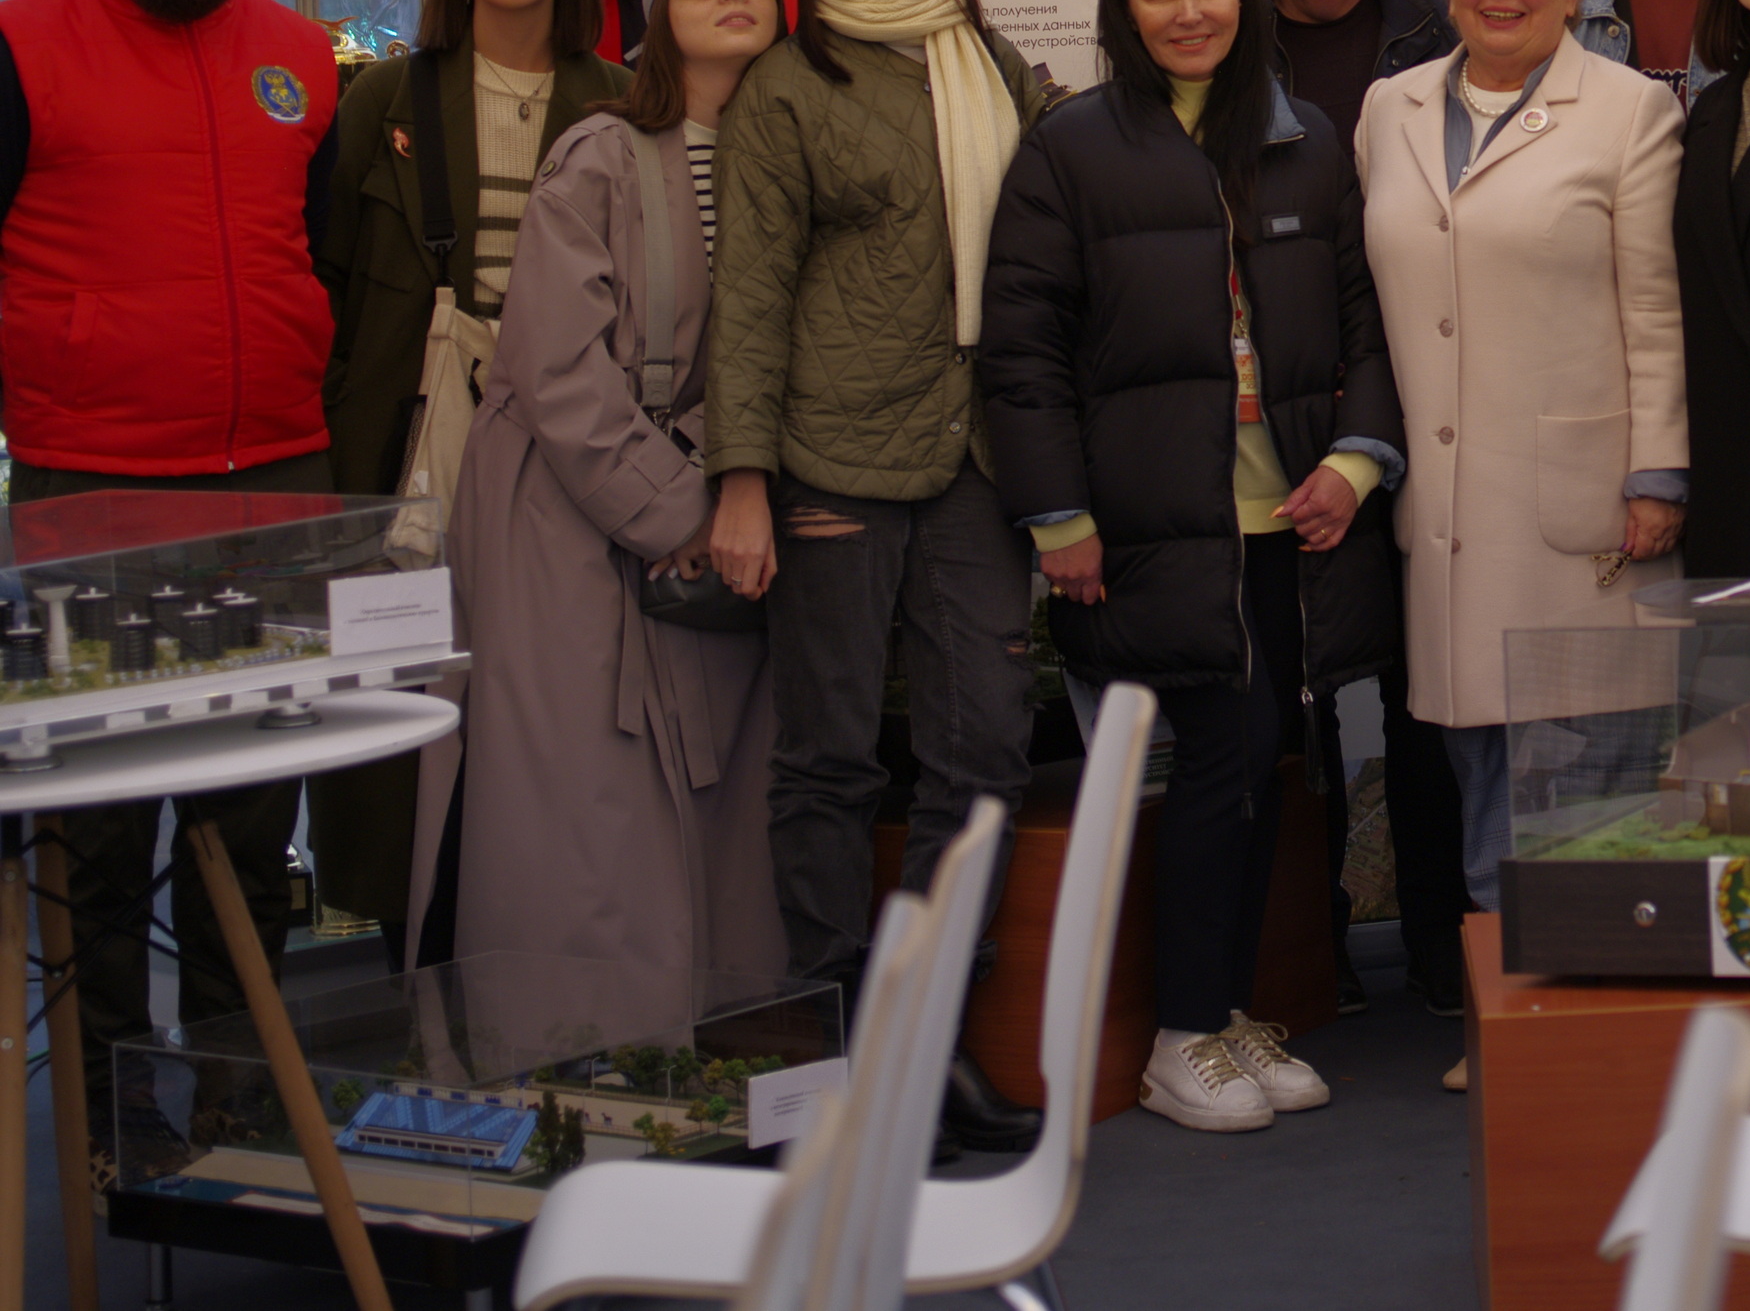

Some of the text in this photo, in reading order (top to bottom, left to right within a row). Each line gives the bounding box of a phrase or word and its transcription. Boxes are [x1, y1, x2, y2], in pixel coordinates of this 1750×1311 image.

[992, 5, 1058, 18] получения
[998, 20, 1091, 33] енных данных
[1011, 34, 1097, 50] леустройств
